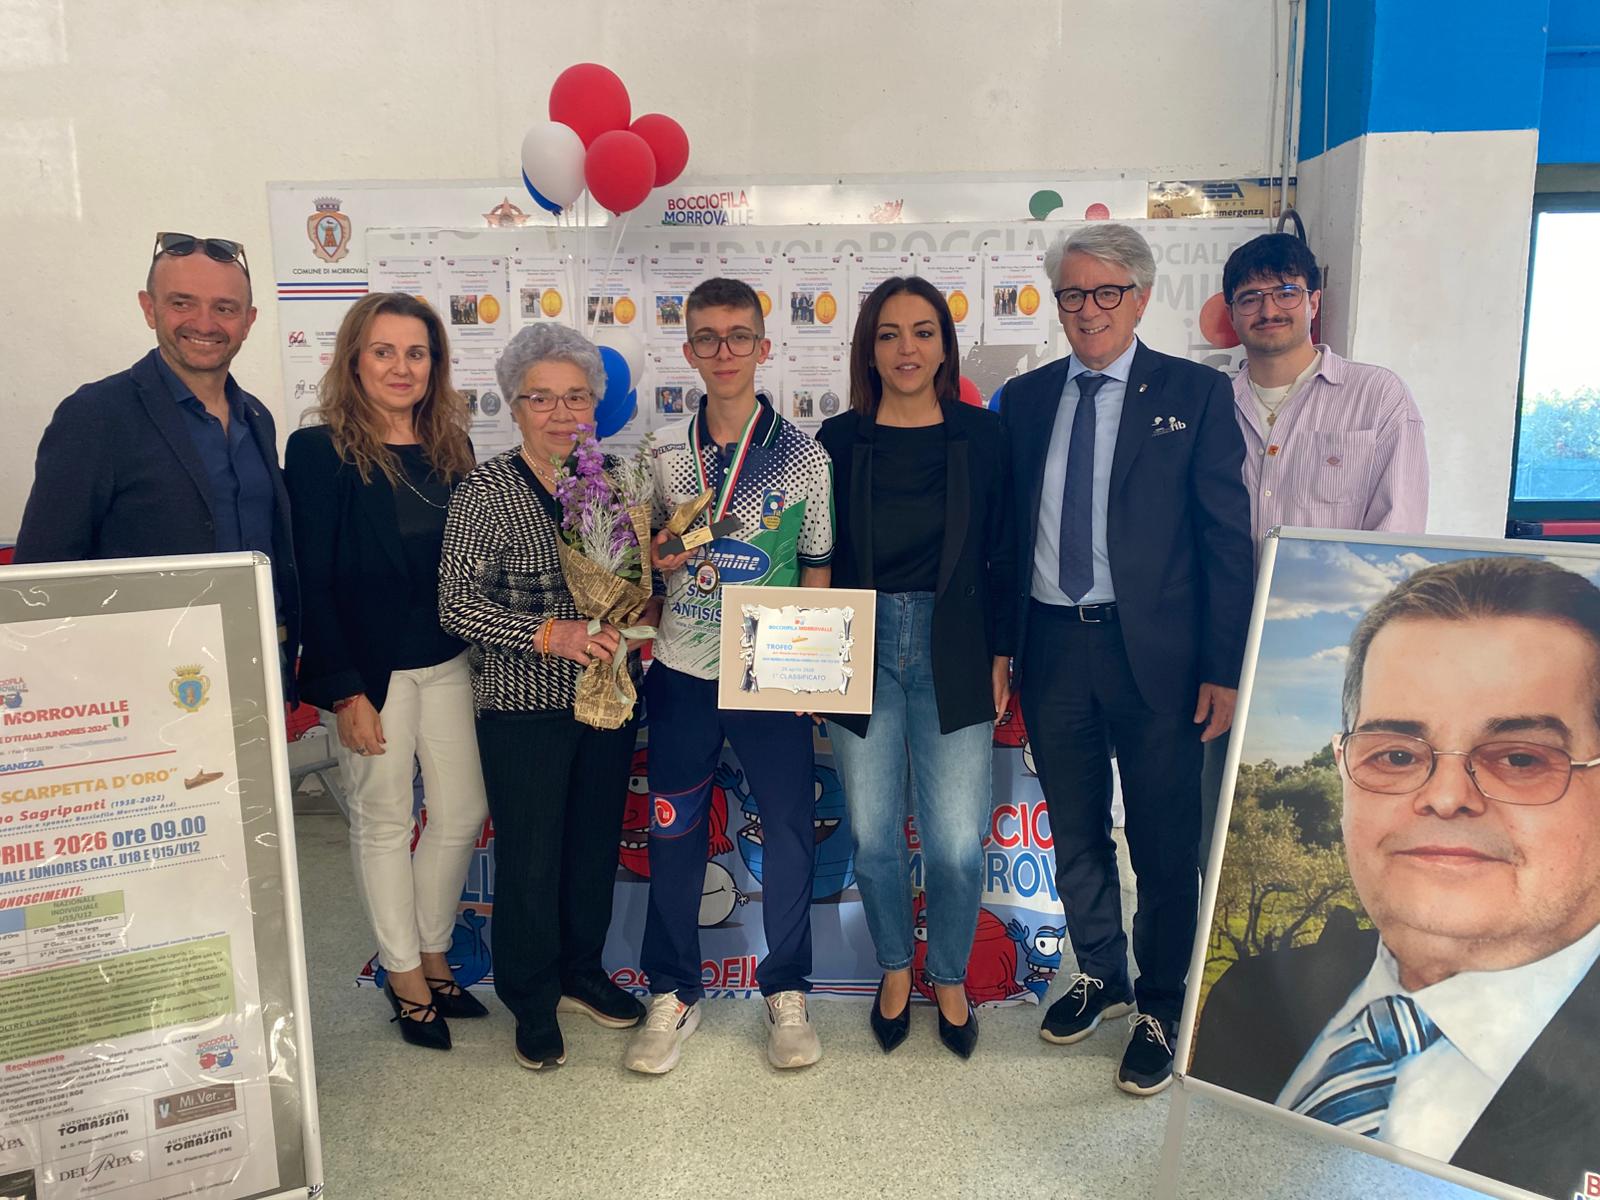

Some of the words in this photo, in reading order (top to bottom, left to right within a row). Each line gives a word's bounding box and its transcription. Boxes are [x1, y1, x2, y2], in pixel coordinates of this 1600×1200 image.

[668, 190, 749, 210] BOCCIOFILA
[664, 209, 753, 225] MORROVALLE
[703, 548, 760, 571] iemme
[780, 673, 826, 681] CLASSIFICATO
[3, 699, 129, 726] MORROVALLE
[5, 734, 43, 744] D'ITALIA
[44, 729, 86, 739] JUNIORES
[1, 777, 108, 804] SCARPETTA
[112, 768, 178, 789] D'ORO"
[19, 798, 106, 822] Sagripanti
[0, 840, 45, 865] RILE
[54, 831, 107, 856] 2026
[112, 827, 146, 847] ore
[151, 815, 206, 841] 09.00
[29, 859, 87, 880] JUNIORES
[90, 854, 117, 871] CAT.
[119, 850, 141, 865] U18
[144, 848, 150, 861] E
[152, 841, 200, 859] U15/U12
[51, 902, 99, 916] INDIVIDUALE
[53, 895, 96, 908] NAZIONALE
[59, 911, 92, 922] U15/U12
[4, 1054, 64, 1073] Regolamento
[57, 1112, 129, 1137] TOMASSINI
[61, 1108, 126, 1128] AUTOTRASPORTI
[164, 1129, 233, 1154] TOMASSINI
